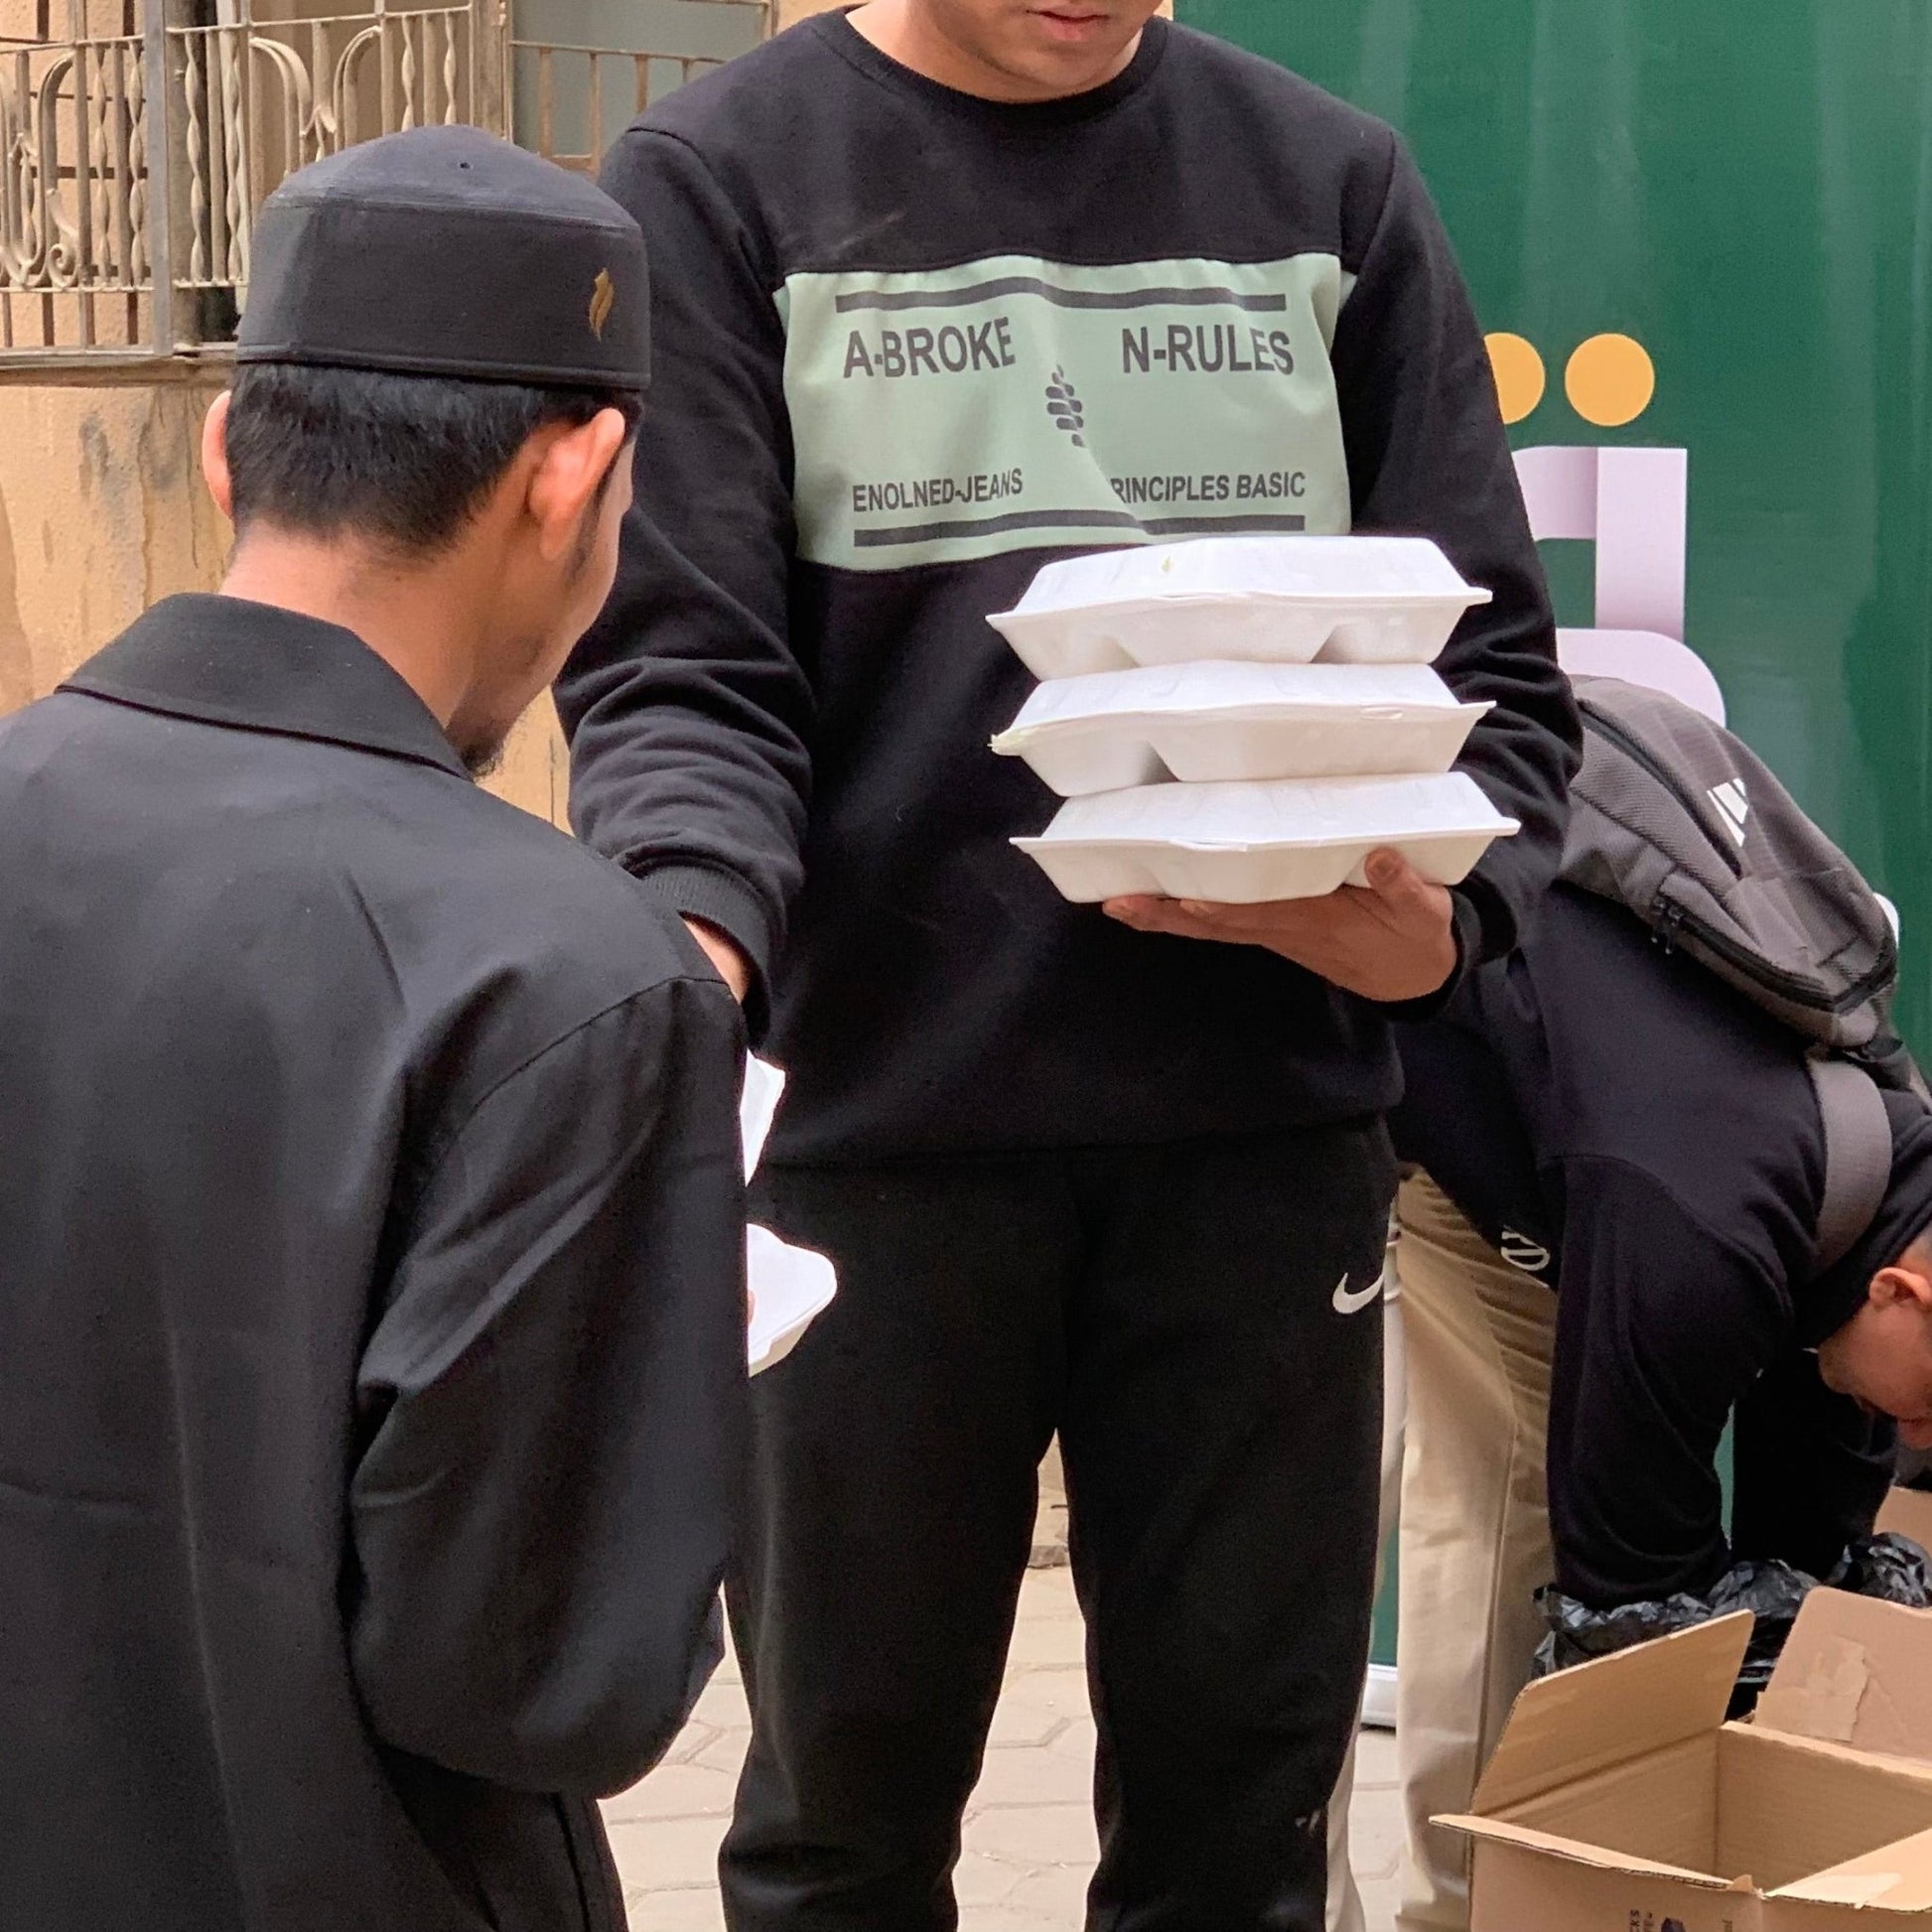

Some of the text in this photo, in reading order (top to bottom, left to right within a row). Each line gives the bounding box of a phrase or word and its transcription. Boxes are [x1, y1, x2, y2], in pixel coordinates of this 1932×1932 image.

[843, 316, 1295, 379] A-BROKE N-RULES
[1110, 475, 1230, 504] RINCIPLES
[1235, 471, 1306, 499] BASIC
